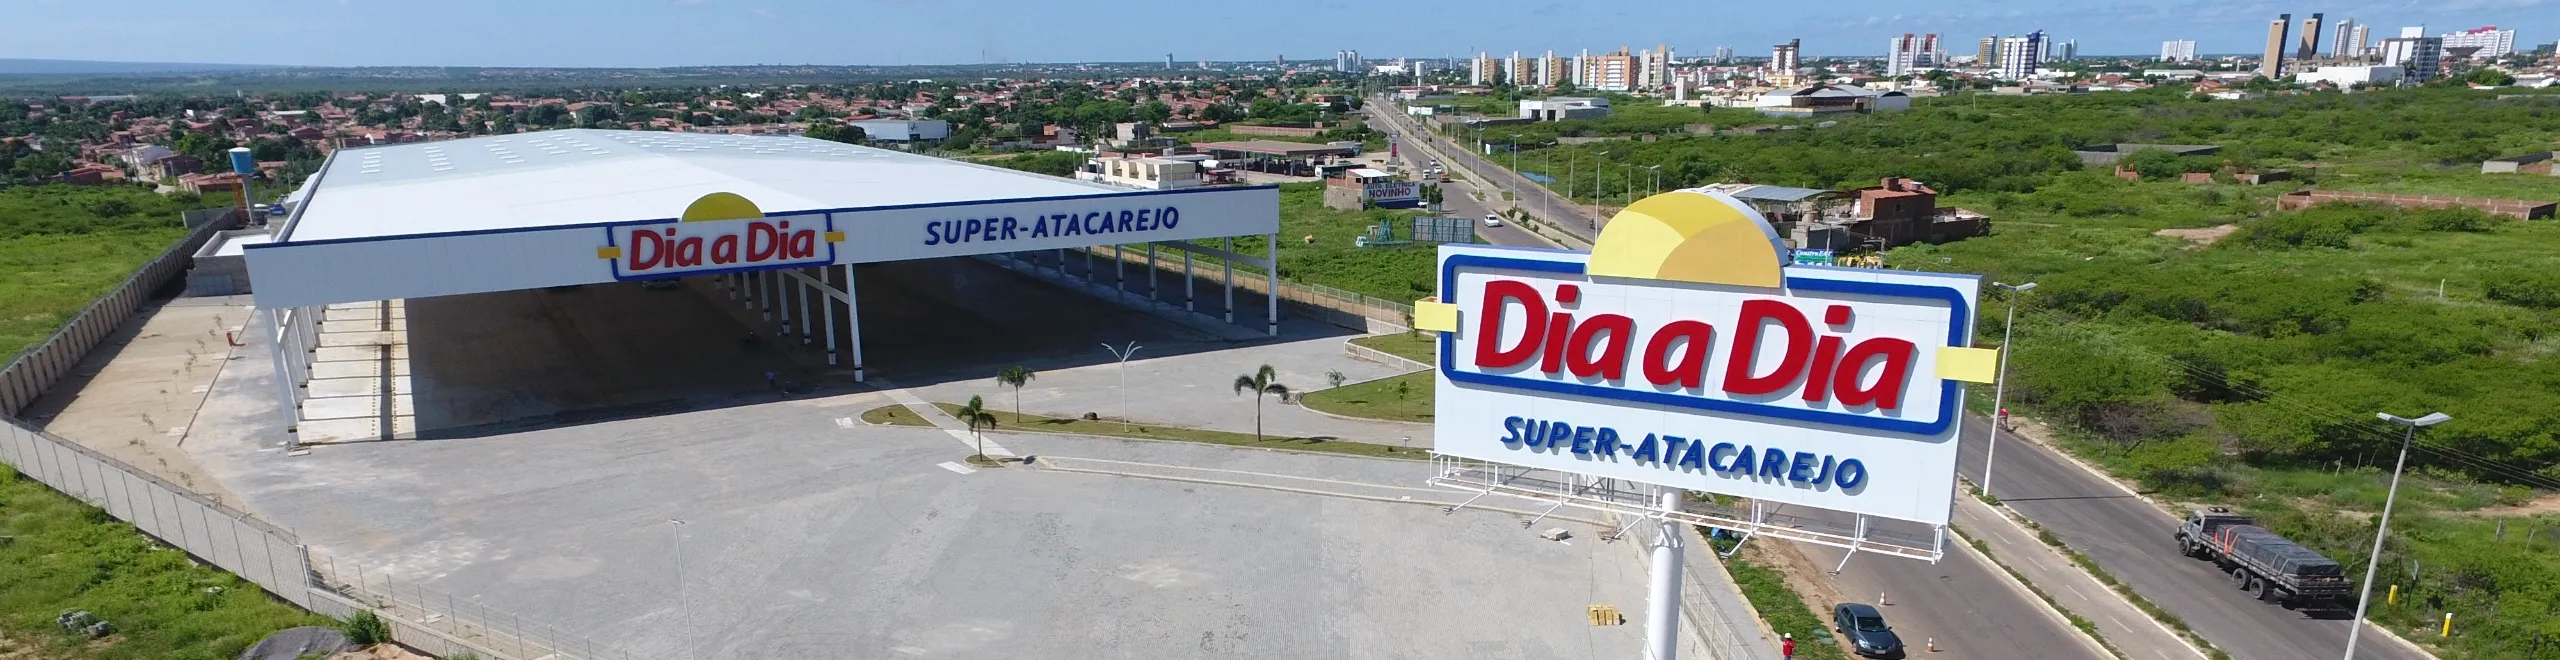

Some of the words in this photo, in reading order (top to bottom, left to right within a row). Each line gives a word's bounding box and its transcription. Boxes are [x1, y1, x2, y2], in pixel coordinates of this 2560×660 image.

[1368, 188, 1411, 198] NOVINHO
[629, 227, 704, 271] Dia
[710, 234, 738, 264] a
[745, 220, 816, 262] Dia
[924, 206, 1180, 246] SUPER-ATACAREJO
[1475, 280, 1633, 381] Dia
[1643, 320, 1714, 388] a
[1722, 299, 1915, 410] Dia
[1500, 415, 1868, 490] SUPER-ATACAREJO
